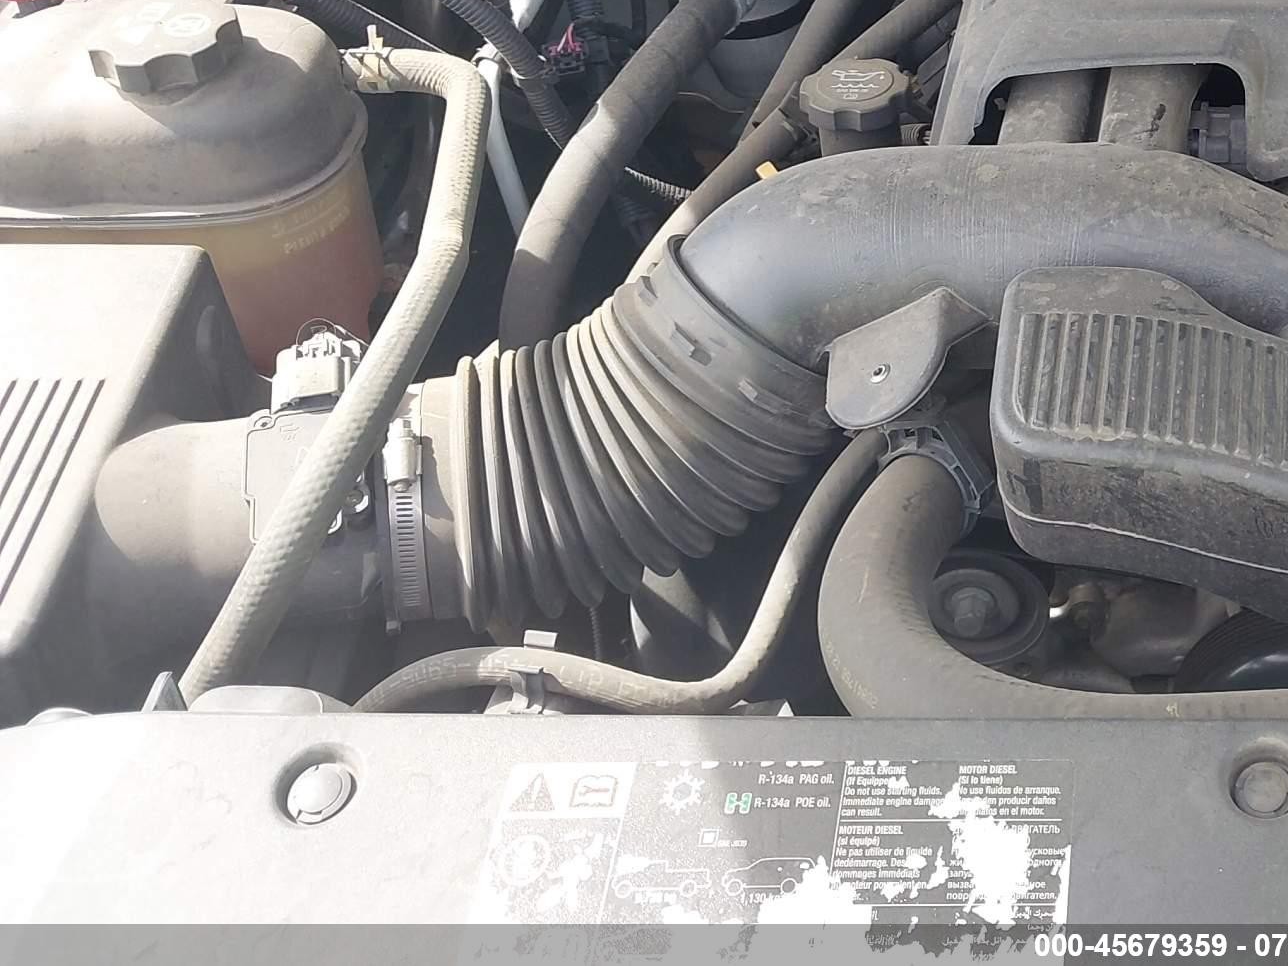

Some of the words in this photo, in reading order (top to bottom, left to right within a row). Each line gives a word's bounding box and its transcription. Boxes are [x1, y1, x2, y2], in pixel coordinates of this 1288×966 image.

[848, 766, 876, 775] DIESEL
[877, 766, 907, 775] ENGINE
[959, 765, 988, 774] MOTOR
[989, 765, 1018, 774] DIESEL
[758, 773, 794, 785] R-134a
[799, 773, 818, 784] PAG
[820, 773, 835, 784] oil.
[980, 775, 1004, 785] tiene)
[844, 787, 855, 796] Do
[856, 787, 870, 796] not
[871, 788, 885, 796] use
[919, 786, 943, 796] fluids.
[969, 787, 984, 795] use
[985, 786, 1012, 795] fluidos
[1013, 786, 1023, 795] de
[1024, 787, 1062, 796] arranque.
[754, 797, 790, 808] R-134a
[795, 797, 815, 808] POE
[816, 797, 831, 808] oil.
[842, 797, 884, 806] Immediate
[885, 797, 912, 808] engine
[998, 796, 1032, 807] producir
[1032, 796, 1057, 805] daños
[841, 808, 856, 817] can
[857, 808, 883, 817] result.
[999, 808, 1009, 816] en
[1010, 807, 1018, 816] el
[1020, 807, 1045, 816] motor.
[838, 825, 873, 835] MOTEUR
[874, 825, 904, 835] DIESEL
[849, 836, 880, 847] équipé)
[835, 847, 847, 856] Ne
[848, 848, 863, 858] pas
[864, 847, 892, 856] utiliser
[893, 847, 904, 856] de
